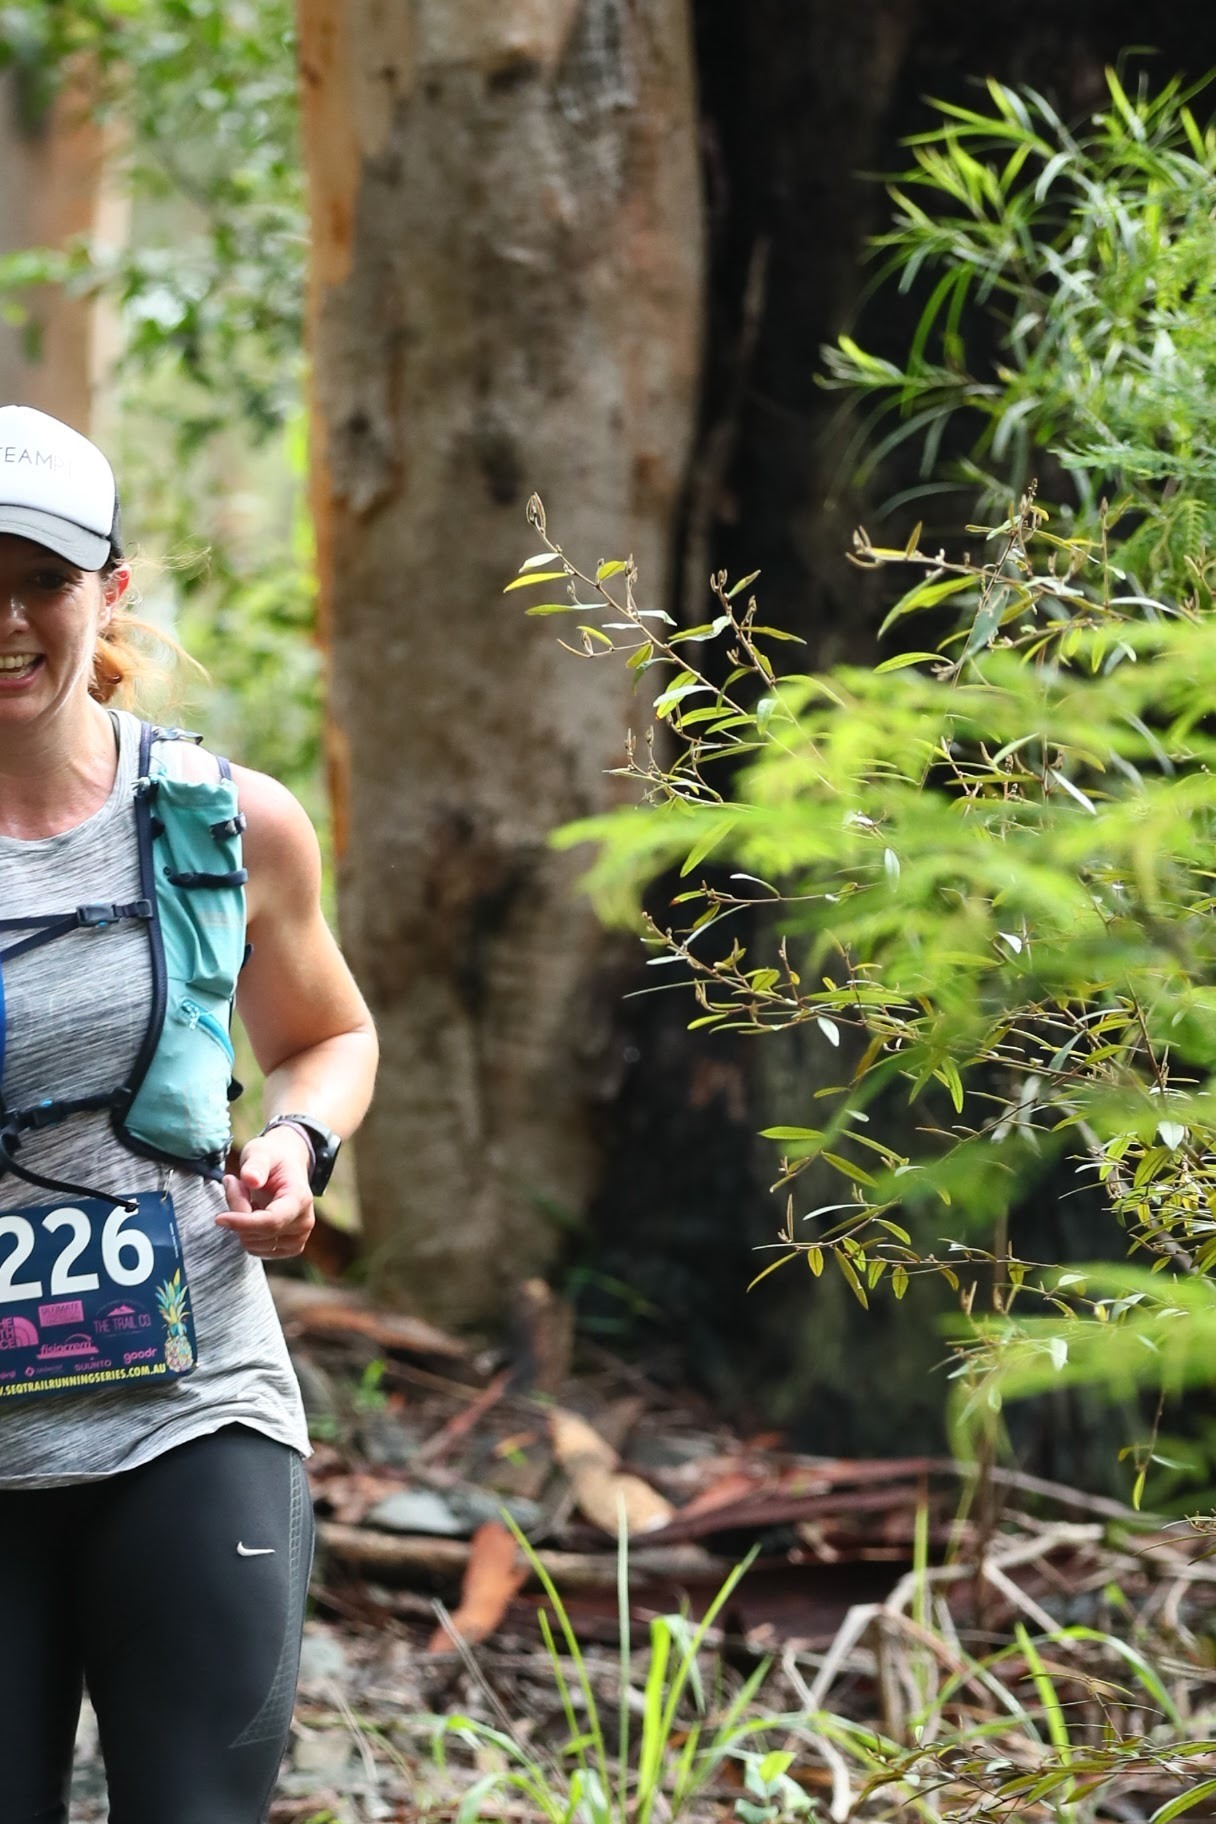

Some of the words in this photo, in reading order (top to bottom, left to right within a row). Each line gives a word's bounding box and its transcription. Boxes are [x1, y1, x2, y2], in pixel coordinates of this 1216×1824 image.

[93, 1319, 110, 1334] THE
[114, 1316, 137, 1330] TRAIL
[124, 1347, 157, 1364] goodr
[74, 1360, 112, 1371] SUUNTO
